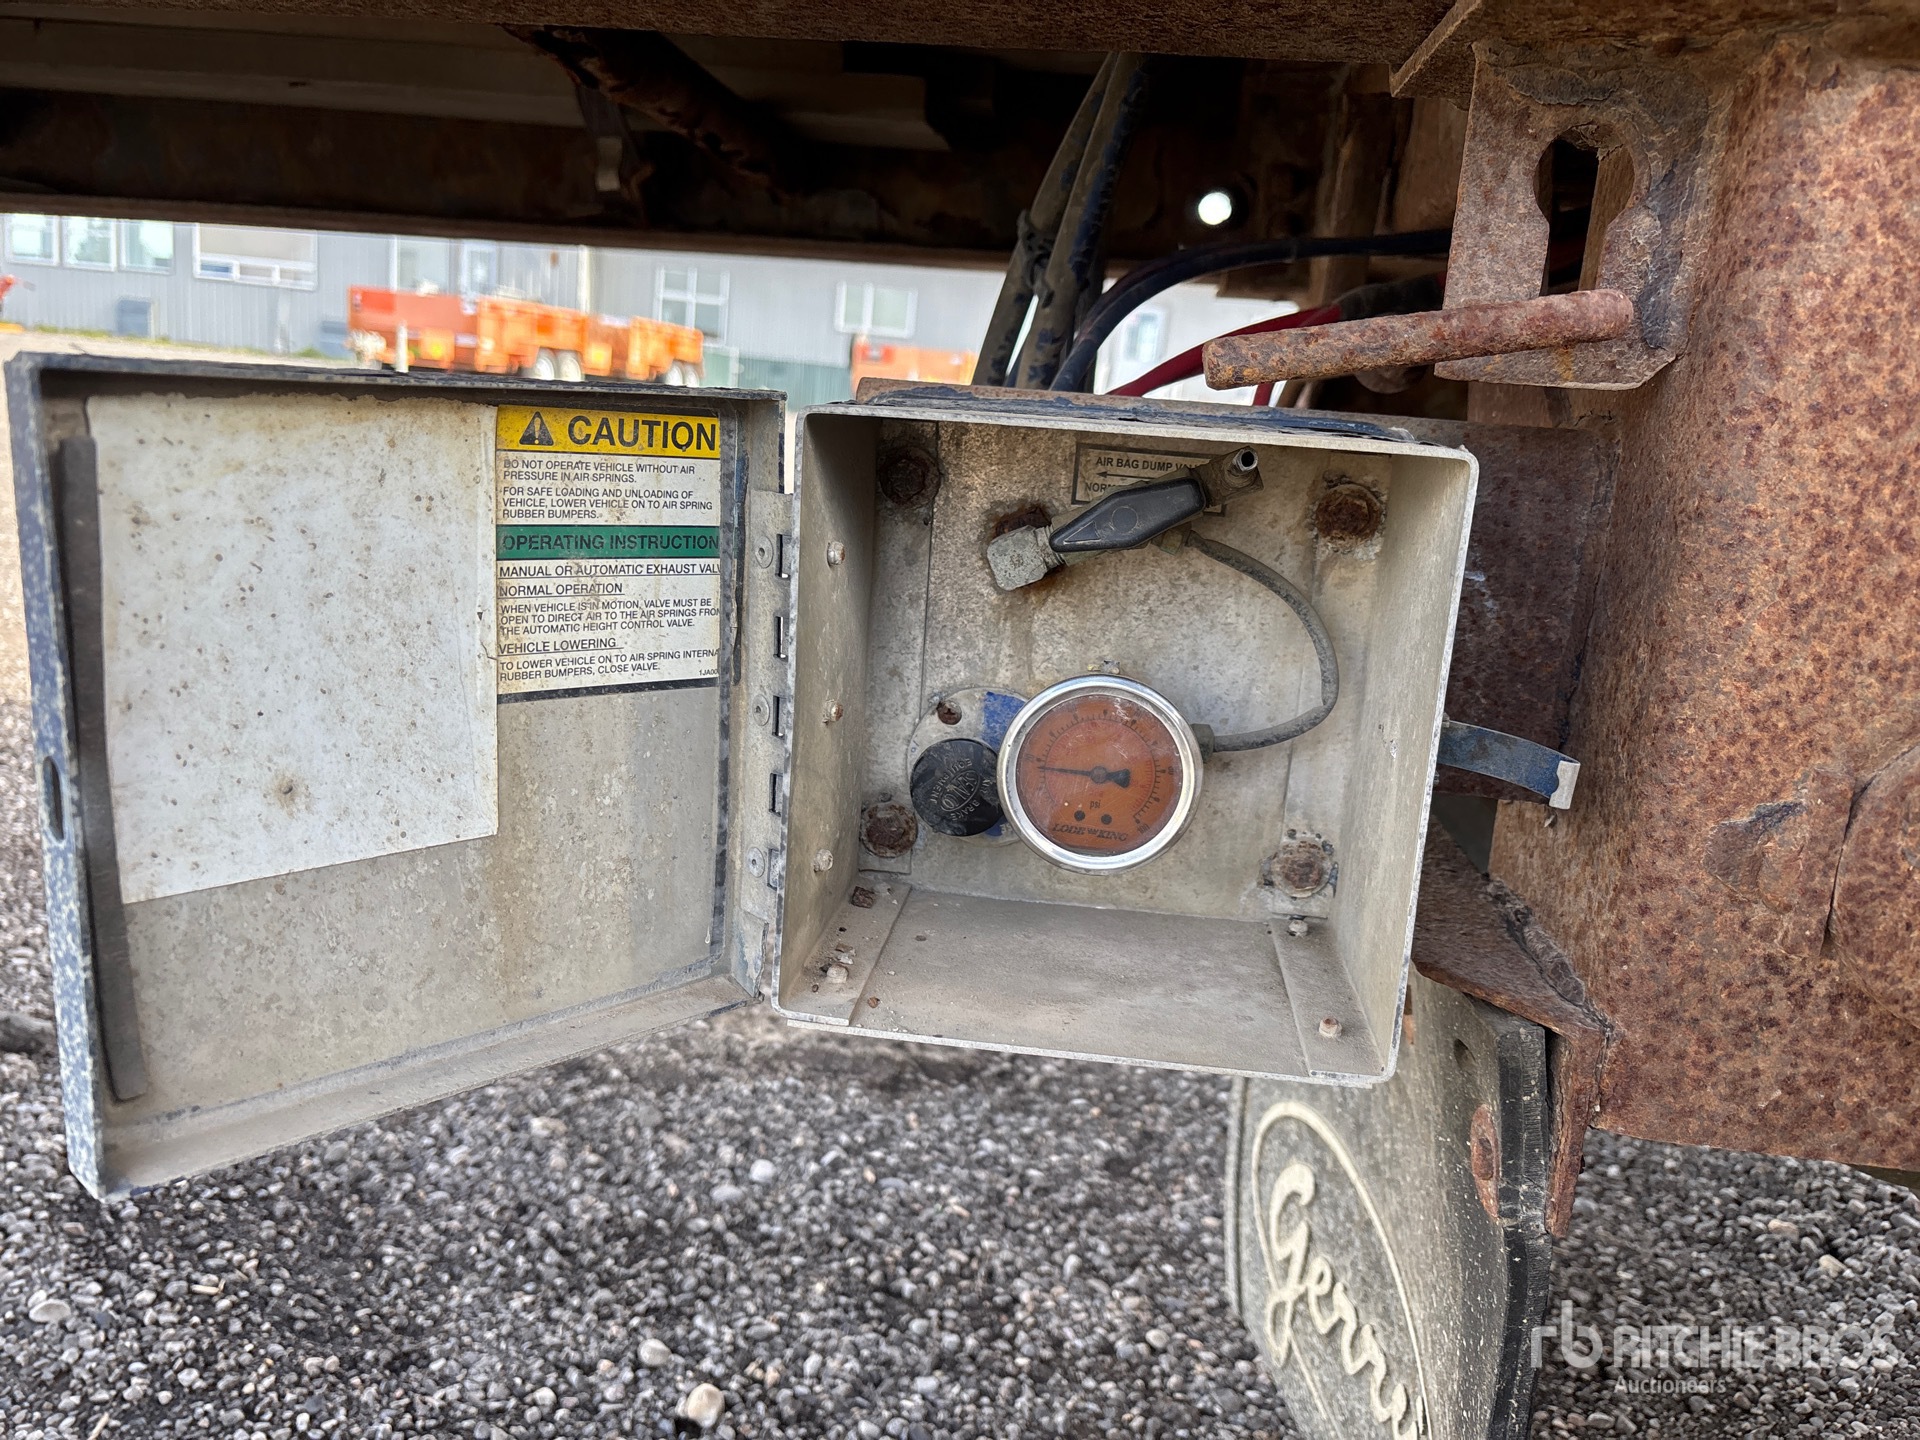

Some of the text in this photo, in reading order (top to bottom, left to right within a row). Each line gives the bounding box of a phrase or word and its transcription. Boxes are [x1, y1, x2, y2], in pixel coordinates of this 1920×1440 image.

[567, 415, 716, 451] CAUTION
[503, 459, 695, 475] DO NOT OPERATE VEHICLE WITHOUT AIR
[1096, 456, 1114, 467] AIR
[1116, 458, 1139, 469] BAG
[1141, 460, 1173, 472] DUMP
[503, 471, 637, 483] PRESSURE IN AIR SPRINGS.
[503, 486, 694, 499] FOR SAFE LOADING AND UNLOADING OF
[503, 498, 713, 510] VEHICLE, LOWER VEHICLE ON TO AIR SPRING
[502, 509, 600, 519] RUBBER BUMPERS.
[503, 534, 719, 550] OPERATING INSTRUCTION
[499, 566, 552, 577] MANUAL
[555, 565, 573, 576] OR
[576, 564, 644, 576] AUTOMATIC
[646, 564, 696, 574] EXHAUST
[499, 583, 623, 597] NORMAL OPERATION
[500, 598, 712, 614] WHEN VEHICLE IS IN MOTION, VALVE MUST BE
[500, 615, 529, 625] OPEN
[531, 614, 545, 623] TO
[548, 613, 584, 623] DIRECT
[586, 612, 602, 621] AIR
[604, 611, 618, 620] TO
[620, 611, 639, 620] THE
[640, 610, 656, 619] AIR
[657, 609, 698, 618] SPRINGS
[500, 618, 695, 636] THE AUTOMATIC HEIGHT CONTROL VALVE.
[499, 638, 616, 654] VEHICLE LOWERING
[500, 661, 514, 671] TO
[516, 660, 553, 670] LOWER
[555, 657, 596, 667] VEHICLE
[597, 655, 612, 664] ON
[614, 654, 628, 663] TO
[630, 653, 645, 662] AIR
[646, 651, 681, 662] SPRING
[500, 662, 661, 682] RUBBER BUMPERS, CLOSE VALVE.
[1089, 799, 1101, 810] psi
